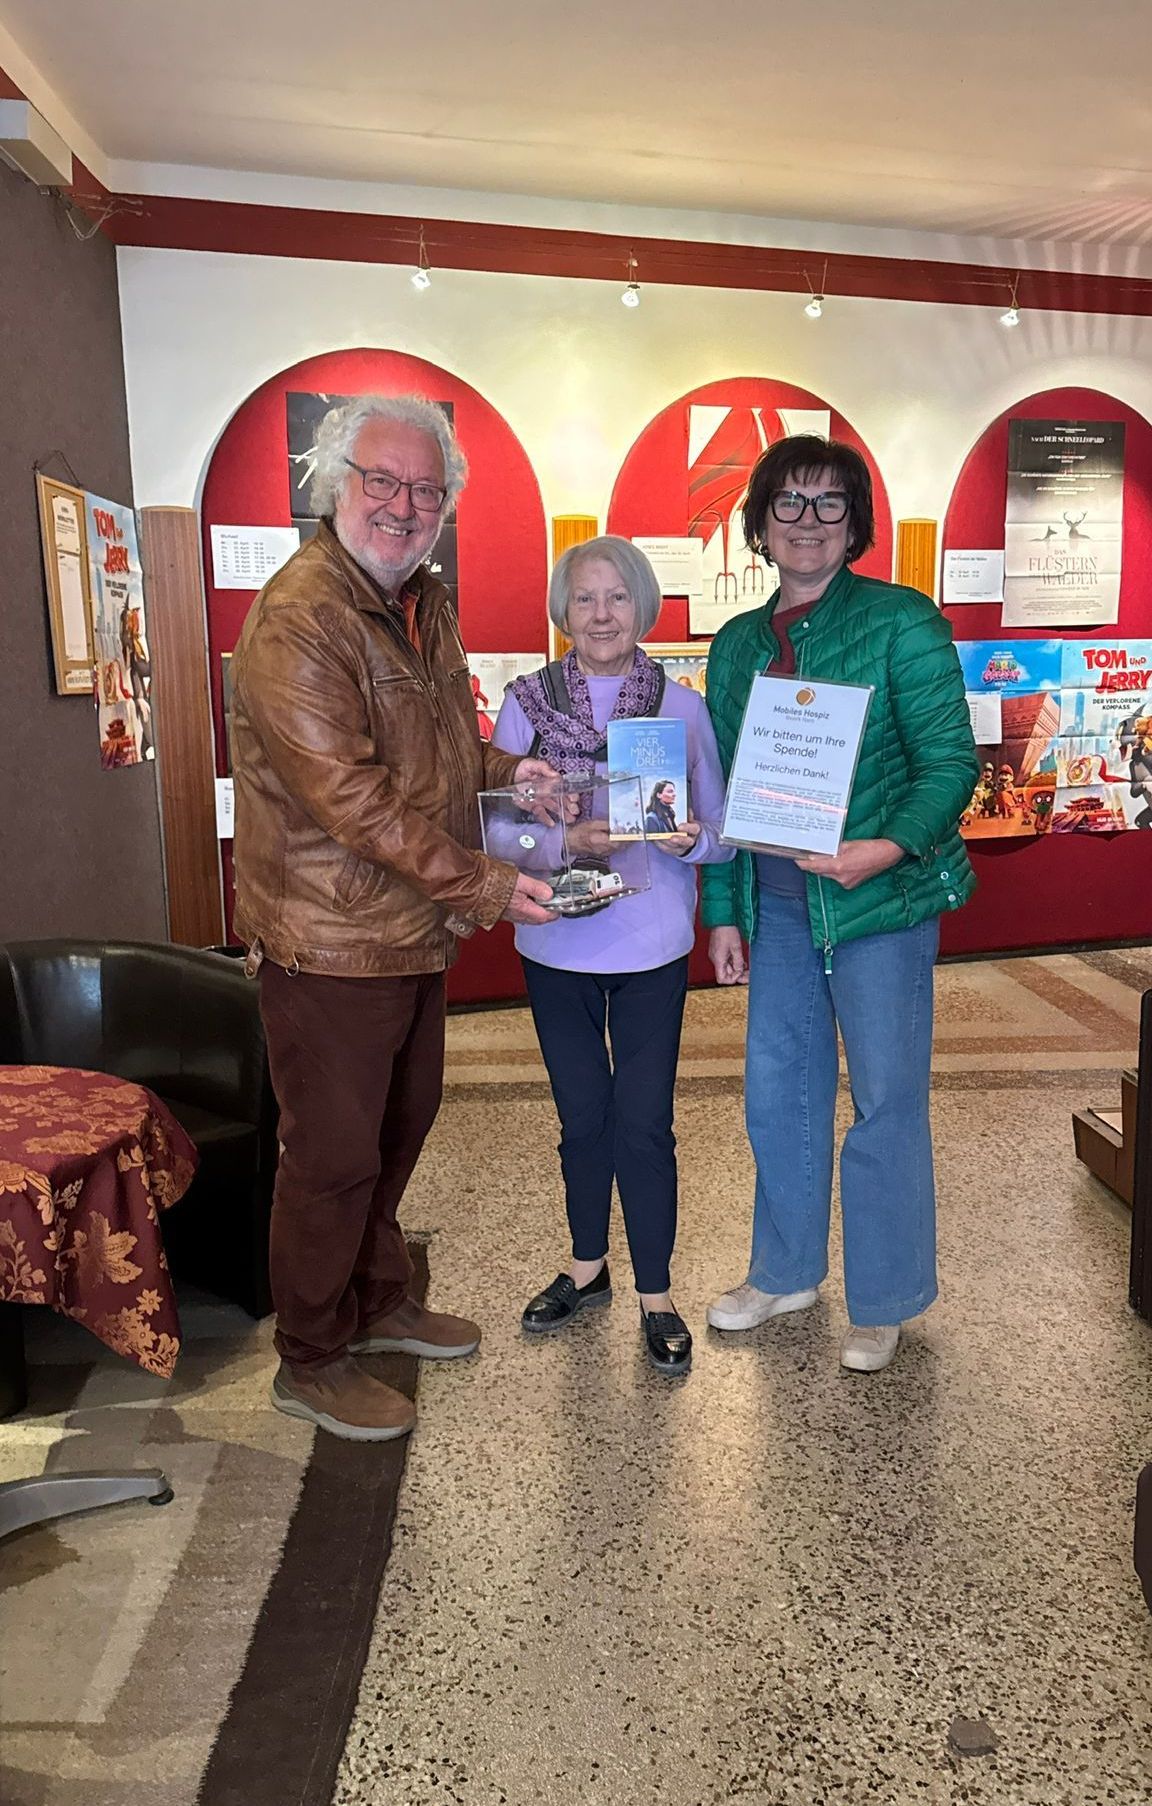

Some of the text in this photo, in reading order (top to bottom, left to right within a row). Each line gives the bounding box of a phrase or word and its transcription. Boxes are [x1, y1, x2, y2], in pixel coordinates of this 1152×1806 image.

[93, 507, 117, 541] TOM
[1028, 554, 1098, 571] FLÜSTERN
[1083, 649, 1146, 670] TOM UND
[1095, 669, 1152, 693] JERRY
[773, 705, 830, 720] Mobiles Hospiz
[637, 736, 660, 747] VIER
[753, 726, 846, 748] Wir bitten um Ihre
[630, 745, 666, 759] MINUS
[773, 742, 818, 759] Spende!
[755, 761, 830, 780] Herzlichen Dank!
